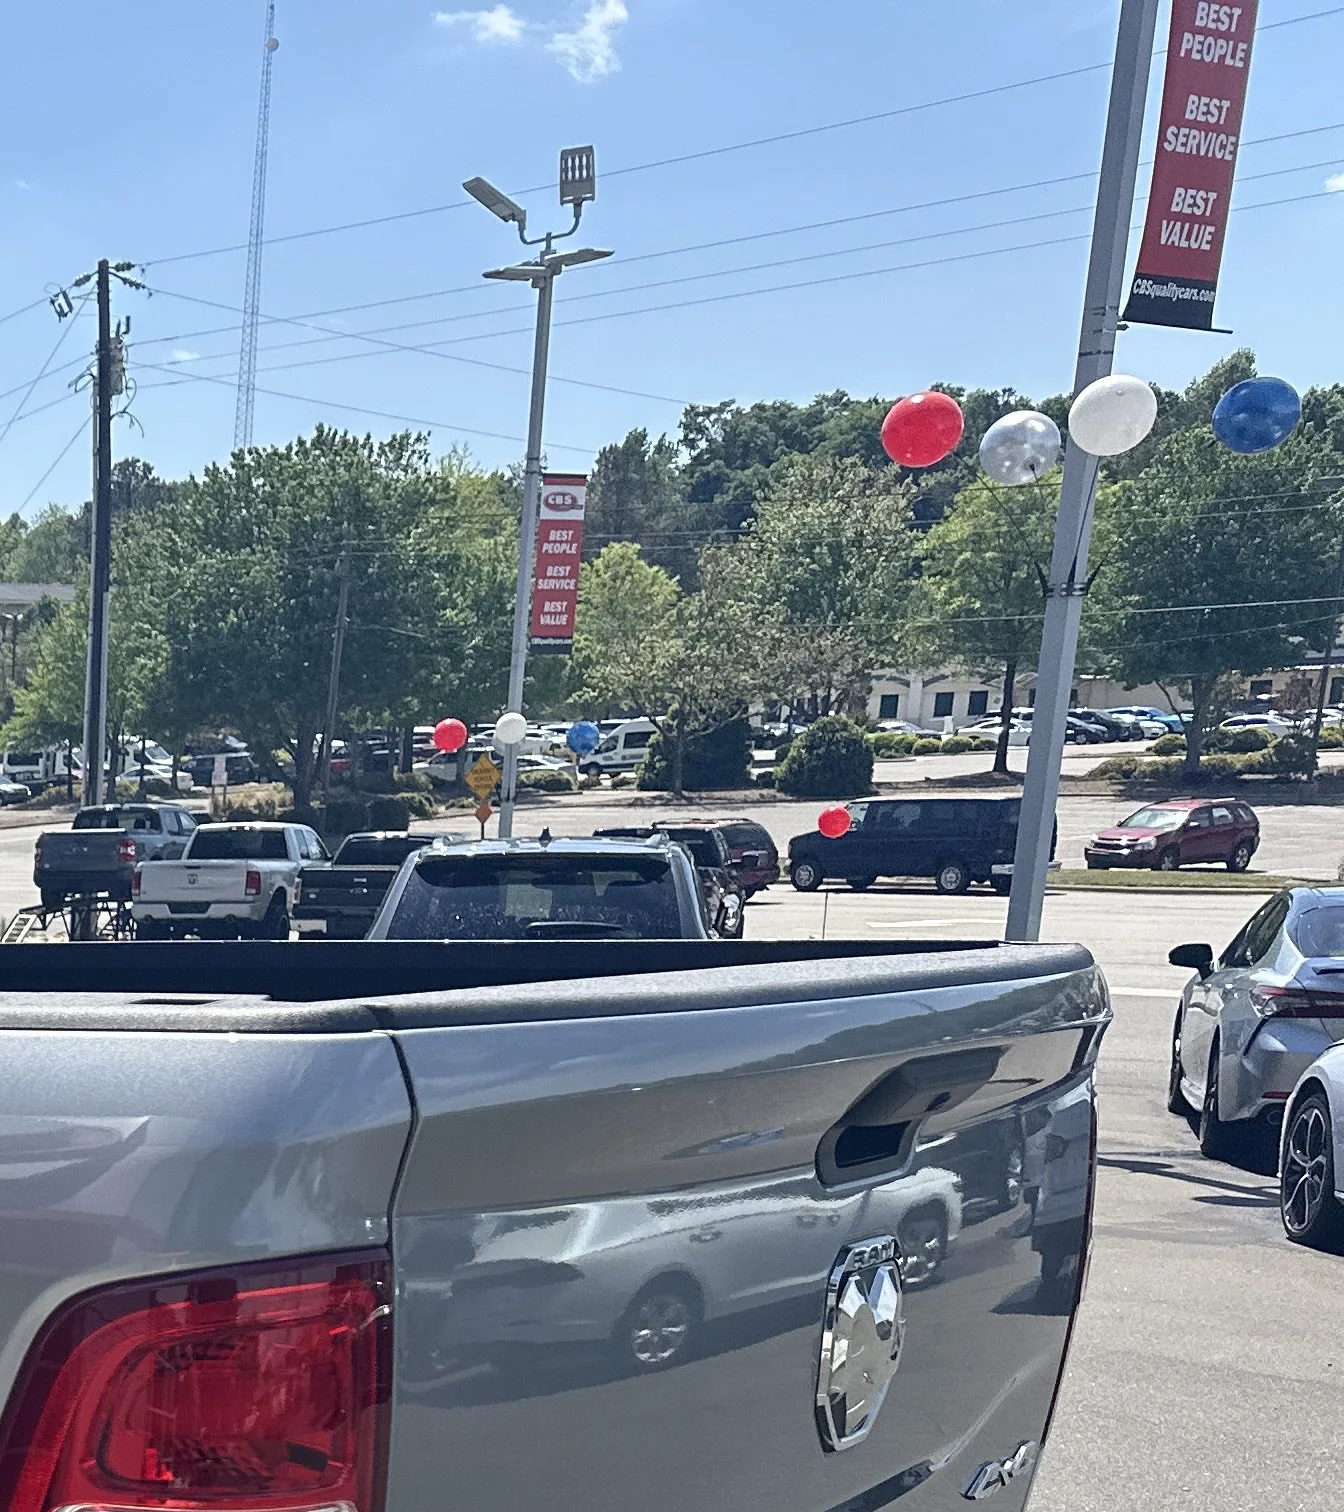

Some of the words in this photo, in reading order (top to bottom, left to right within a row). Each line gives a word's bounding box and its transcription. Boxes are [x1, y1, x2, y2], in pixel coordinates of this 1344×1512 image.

[1195, 1, 1241, 33] BEST
[1180, 32, 1248, 69] PEOPLE
[1185, 94, 1230, 125] BEST
[1164, 126, 1237, 161] SERVICE
[1170, 187, 1217, 217] BEST
[1160, 220, 1215, 251] VALUE
[547, 494, 573, 505] CBS
[549, 529, 574, 541] BEST
[542, 542, 578, 554] PEOPLE
[546, 565, 571, 577] BEST
[537, 578, 576, 590] SERVICE
[543, 601, 568, 613] BEST
[540, 613, 568, 625] VALUE
